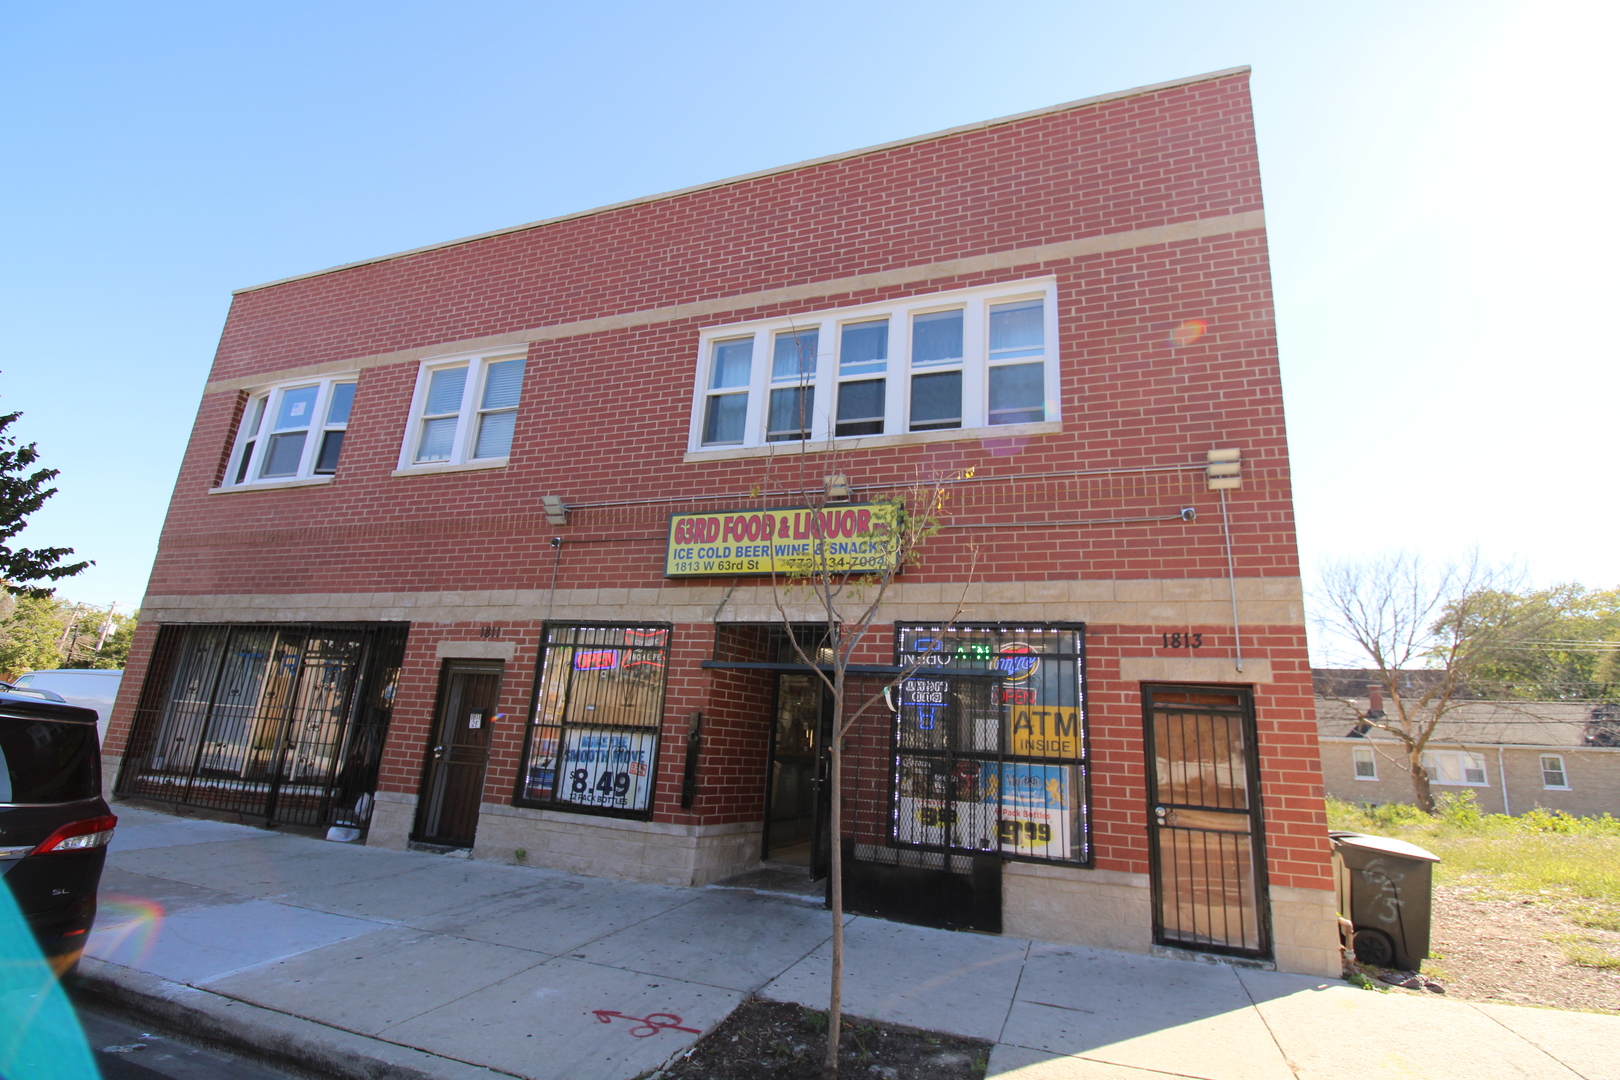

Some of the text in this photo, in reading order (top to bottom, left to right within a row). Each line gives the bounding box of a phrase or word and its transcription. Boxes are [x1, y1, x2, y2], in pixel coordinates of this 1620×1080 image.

[674, 517, 720, 545] 63RD
[722, 514, 776, 543] FOOD
[778, 516, 790, 539] &
[793, 509, 871, 540] LIQUOR
[673, 548, 694, 560] ICE
[697, 546, 732, 559] COLD
[774, 543, 810, 556] WINE
[675, 556, 885, 571] 1813 W 63rd St 773434-7004
[480, 626, 500, 638] 1811
[1162, 632, 1203, 649] 1813
[577, 653, 614, 668] OPEN
[993, 688, 1036, 705] OPEN
[1013, 711, 1078, 738] ATM
[581, 736, 608, 747] MAKE
[1020, 739, 1071, 752] INSIDE
[565, 749, 645, 763] SMOOTH MOVE
[570, 769, 630, 797] $8.49
[578, 794, 596, 802] PACK
[598, 796, 628, 805] BOTTLES
[1003, 809, 1021, 817] Pack
[1023, 811, 1051, 820] Bottles
[52, 888, 70, 896] SL
